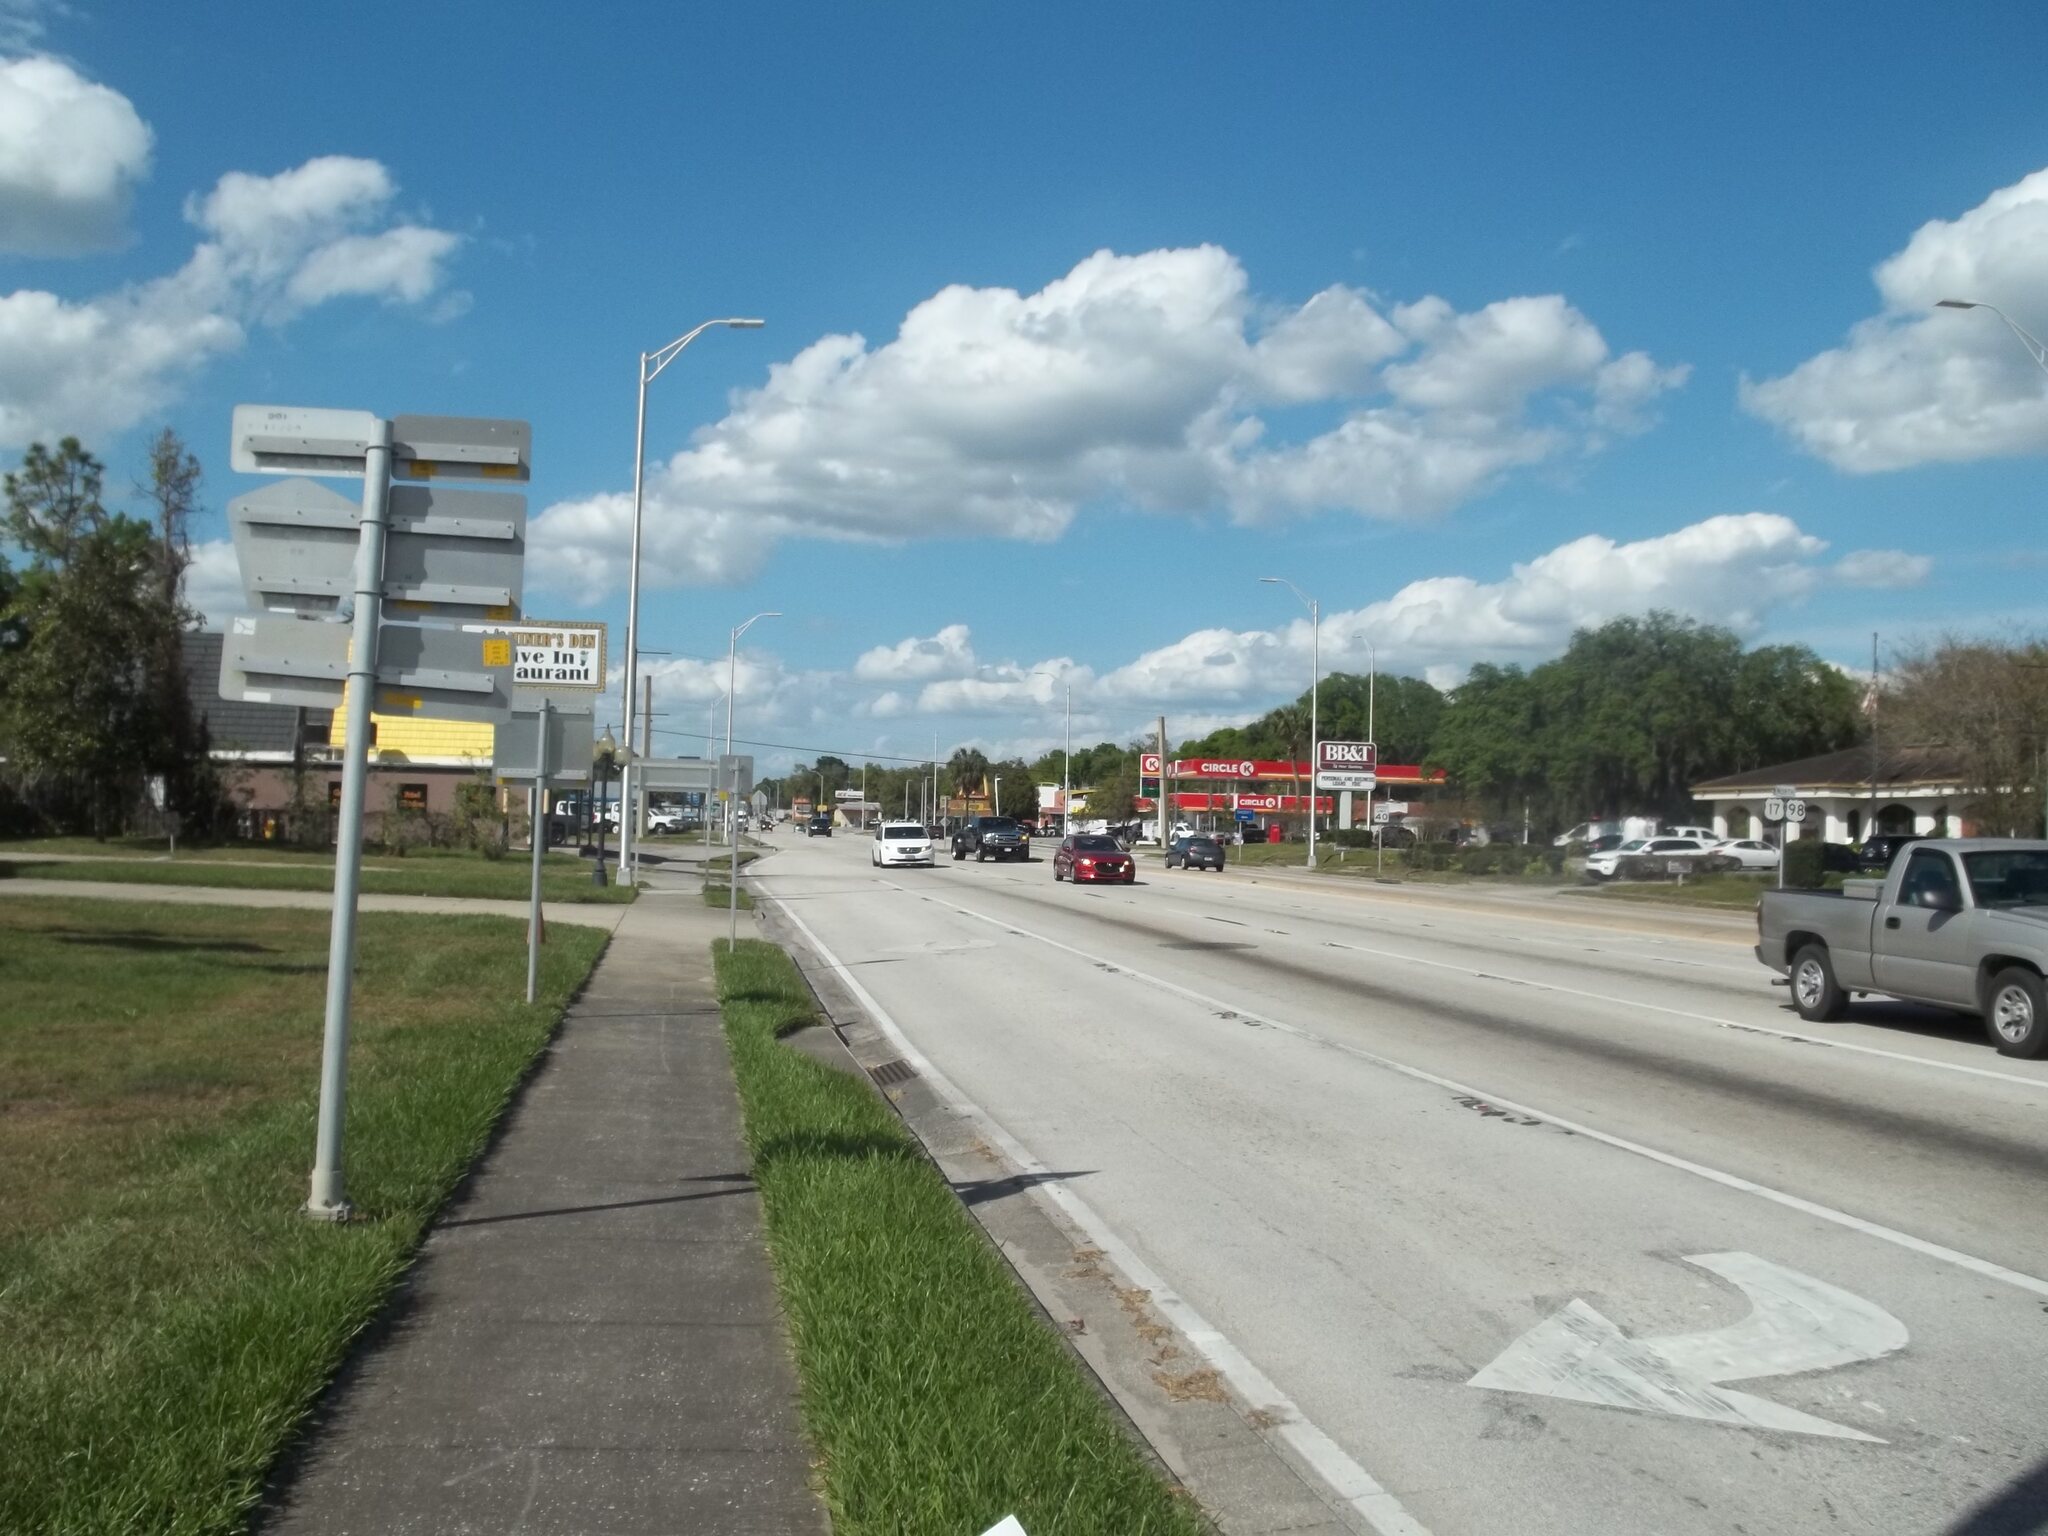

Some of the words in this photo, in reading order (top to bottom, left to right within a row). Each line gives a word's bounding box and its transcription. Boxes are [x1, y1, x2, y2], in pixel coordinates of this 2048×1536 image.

[569, 634, 596, 648] DEN
[553, 651, 574, 664] In
[1325, 744, 1372, 762] BB&T
[1201, 763, 1238, 773] CIRCLE
[1769, 803, 1780, 815] 17
[1788, 803, 1804, 816] 98
